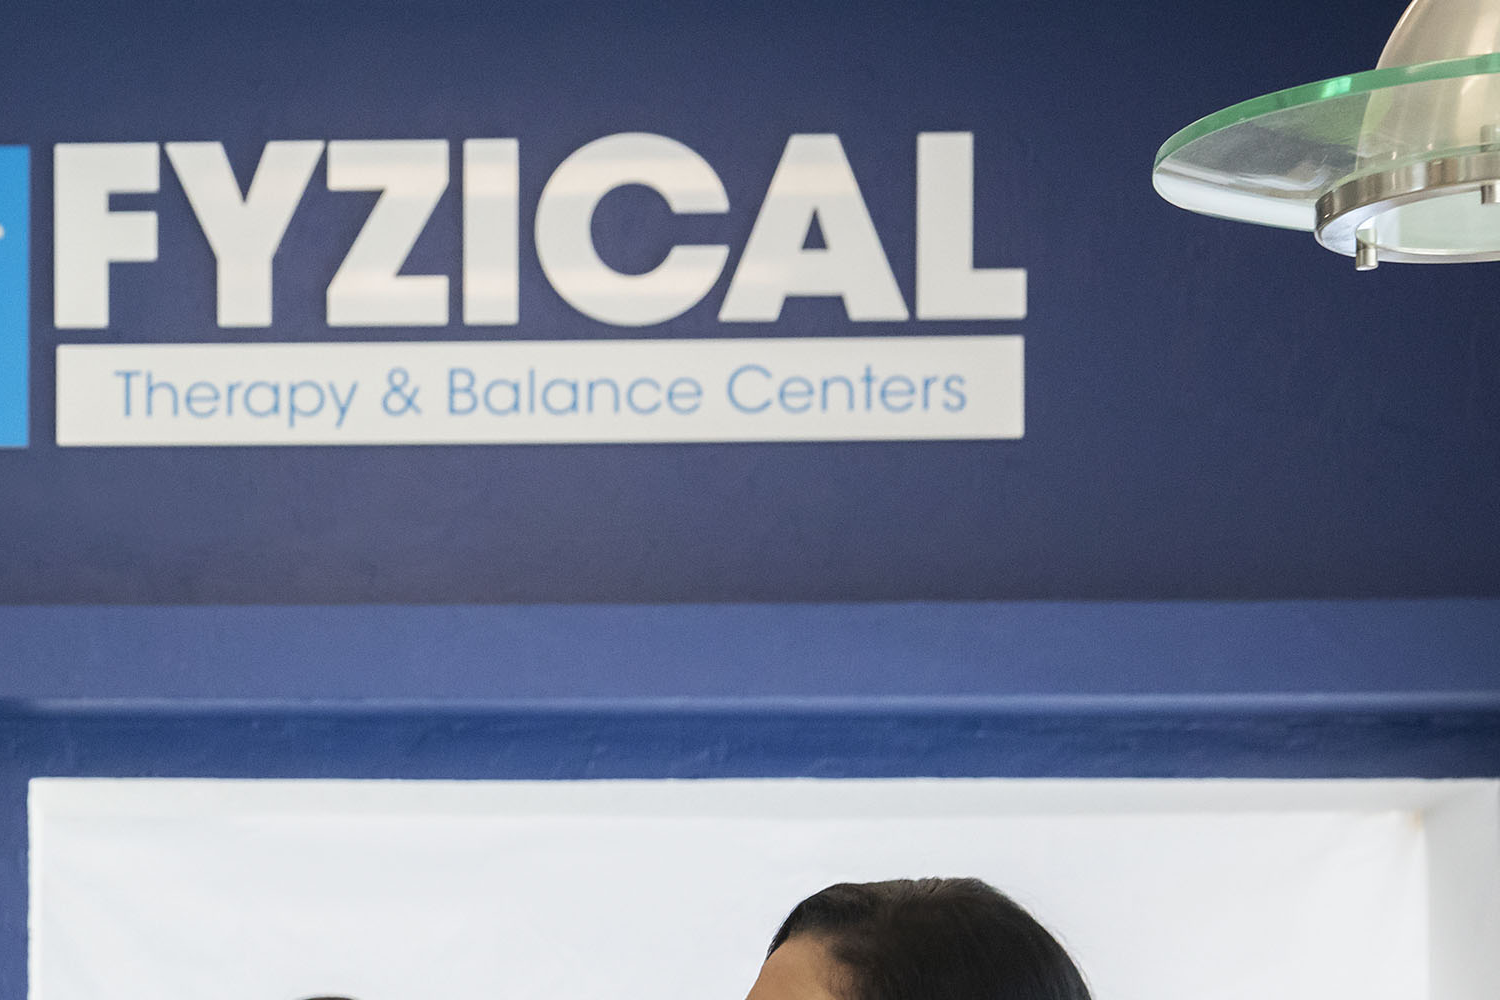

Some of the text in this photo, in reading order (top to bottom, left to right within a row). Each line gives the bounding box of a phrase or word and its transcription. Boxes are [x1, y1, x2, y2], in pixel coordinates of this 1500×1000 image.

[54, 131, 1028, 328] FYZICAL
[113, 363, 969, 428] Therapy & Balance Centers
